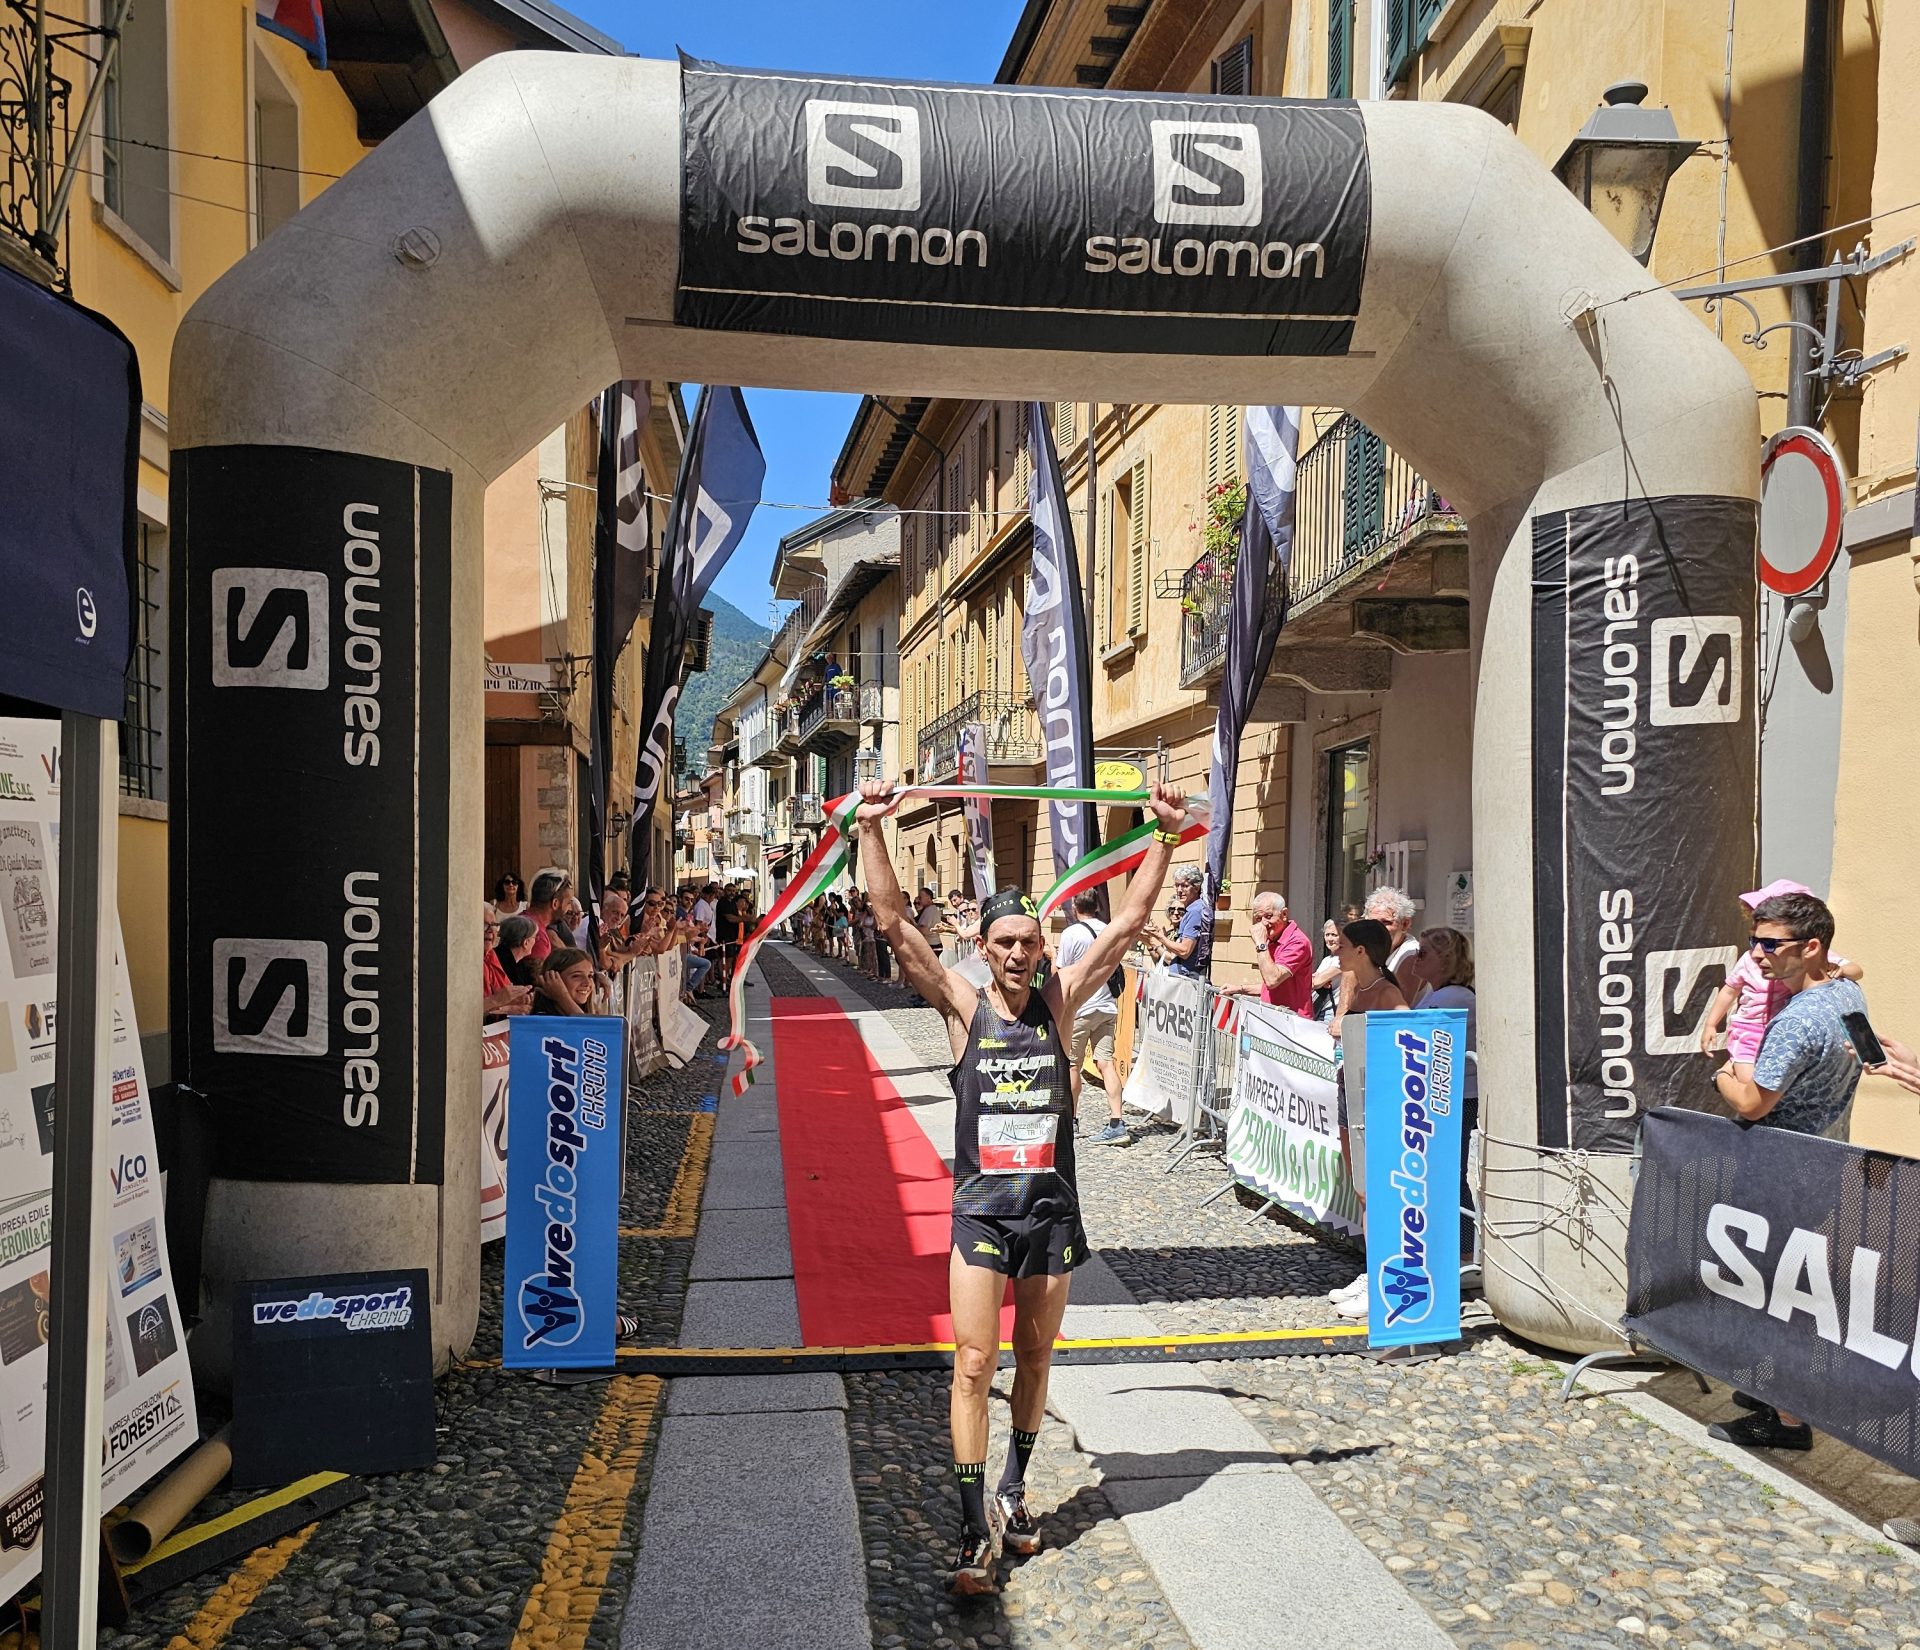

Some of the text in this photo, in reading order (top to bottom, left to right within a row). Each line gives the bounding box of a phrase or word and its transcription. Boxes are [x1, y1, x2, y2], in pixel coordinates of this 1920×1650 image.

[736, 215, 988, 268] salomon
[1084, 235, 1325, 279] salomon
[343, 502, 382, 768] salomon
[496, 665, 513, 675] VIA
[1600, 554, 1639, 796] salomon
[343, 871, 381, 1128] salomon
[1148, 998, 1197, 1043] FORES
[1598, 888, 1638, 1119] salomon
[581, 1038, 607, 1129] CHRONO
[1431, 1029, 1452, 1115] CHRONO
[1244, 1072, 1330, 1137] IMPRESA EDILE
[111, 1154, 147, 1194] VCO
[536, 1038, 586, 1289] wedosport
[1012, 1145, 1028, 1167] 4
[1390, 1030, 1434, 1268] wedosport
[122, 1177, 149, 1193] CONSULTING
[29, 1204, 50, 1223] EDILE
[255, 1288, 410, 1322] wedosport
[350, 1309, 410, 1328] CHRONO
[1700, 1203, 1920, 1382] SAL
[110, 1402, 165, 1459] FORESTI
[6, 1490, 44, 1527] FRATELLI
[12, 1507, 42, 1538] PERONI
